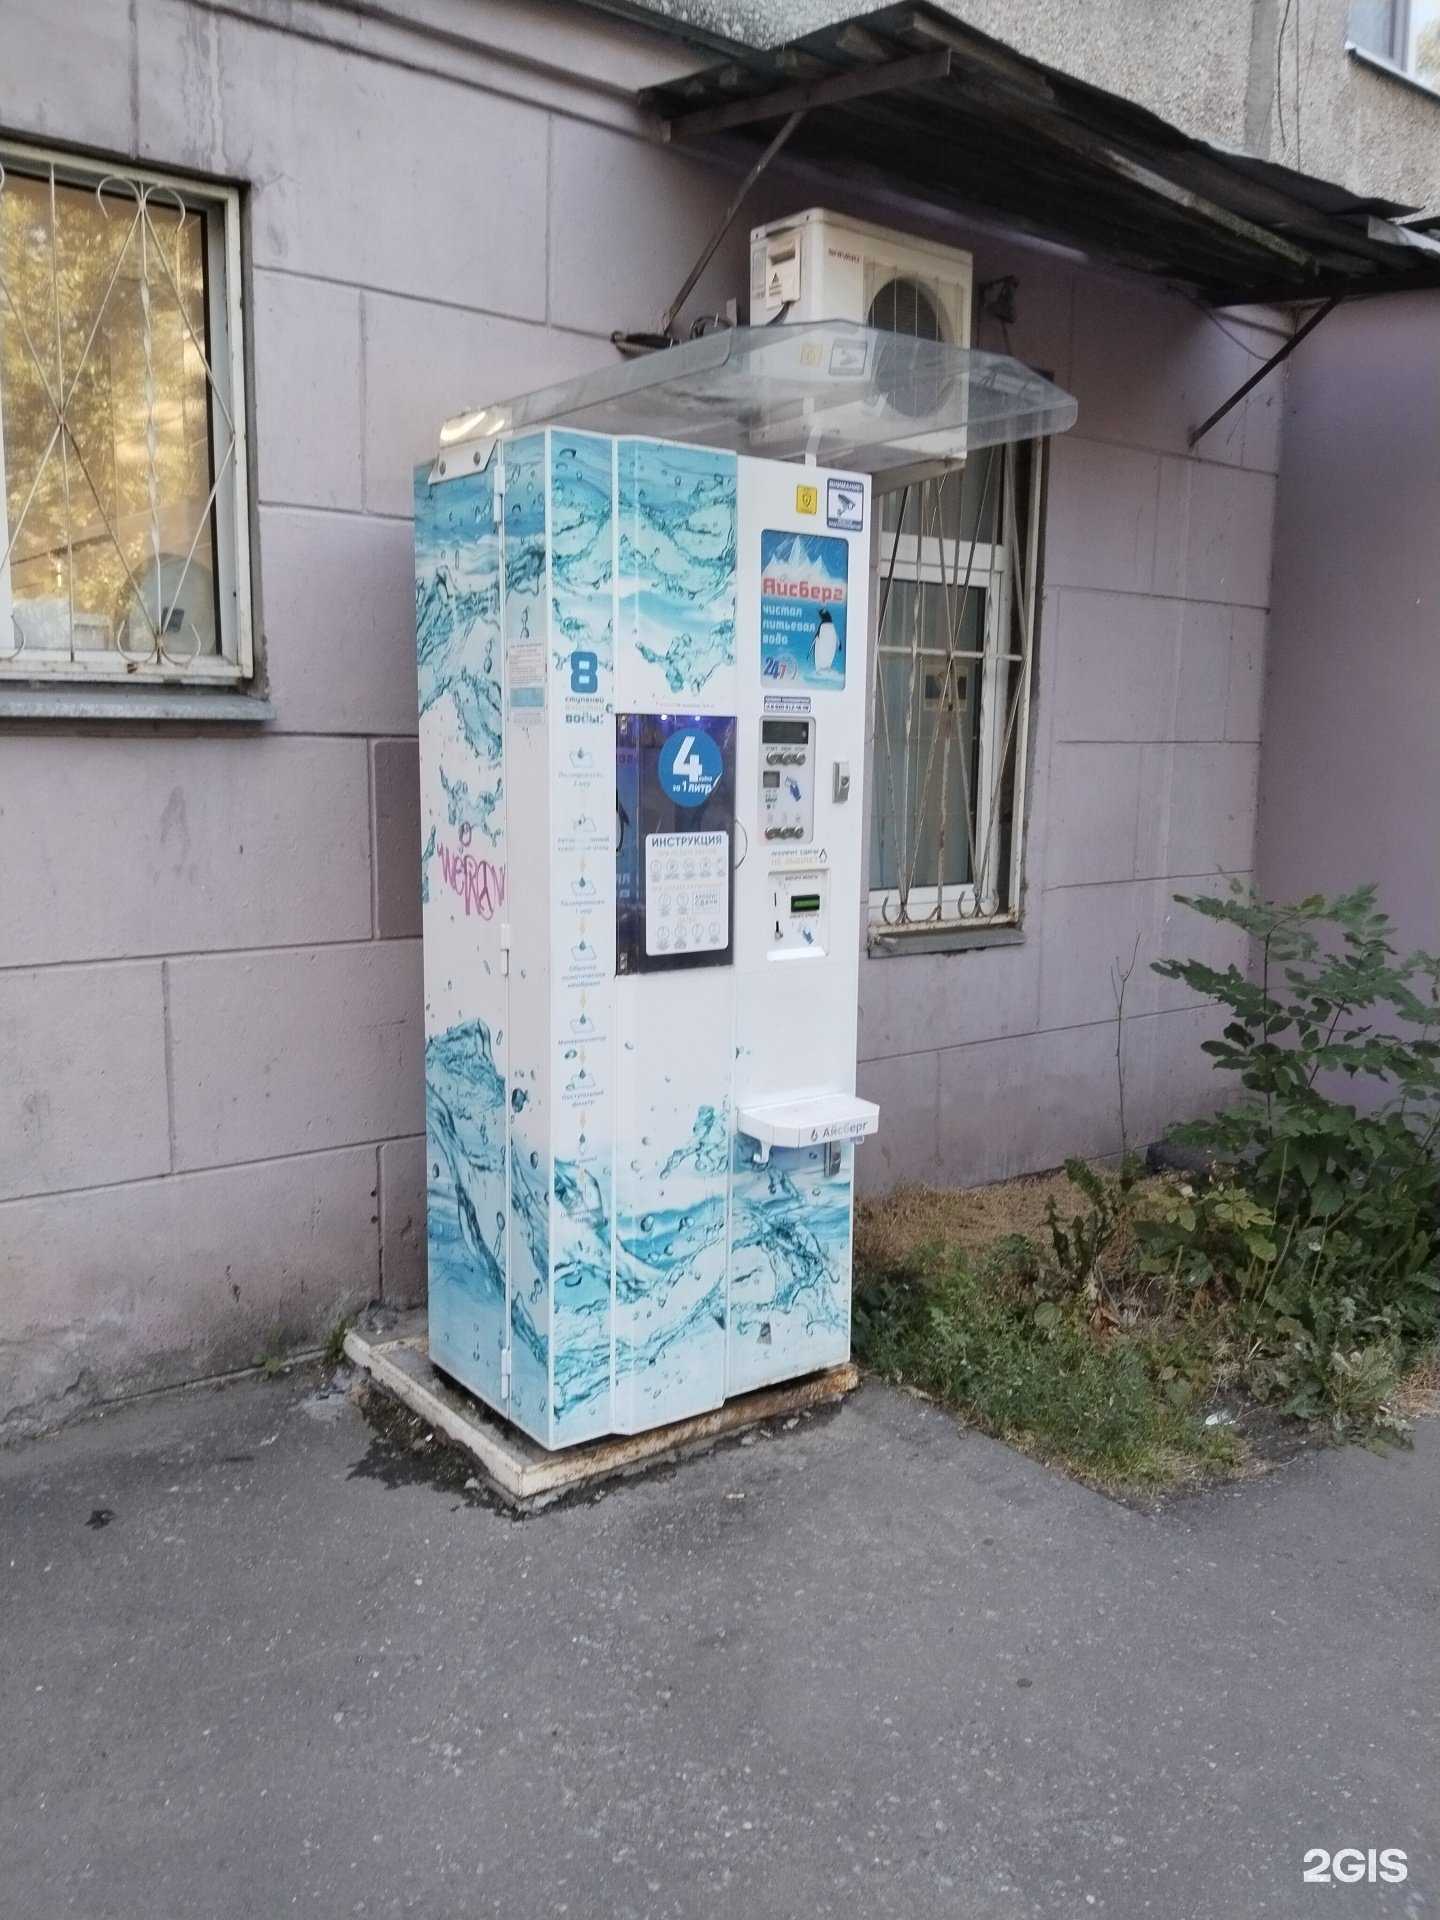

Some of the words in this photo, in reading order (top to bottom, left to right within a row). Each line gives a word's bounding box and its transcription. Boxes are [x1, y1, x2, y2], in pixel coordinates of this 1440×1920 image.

[571, 652, 598, 693] 8
[673, 736, 702, 782] 4
[651, 835, 722, 848] ИНСТРУКЦИЯ
